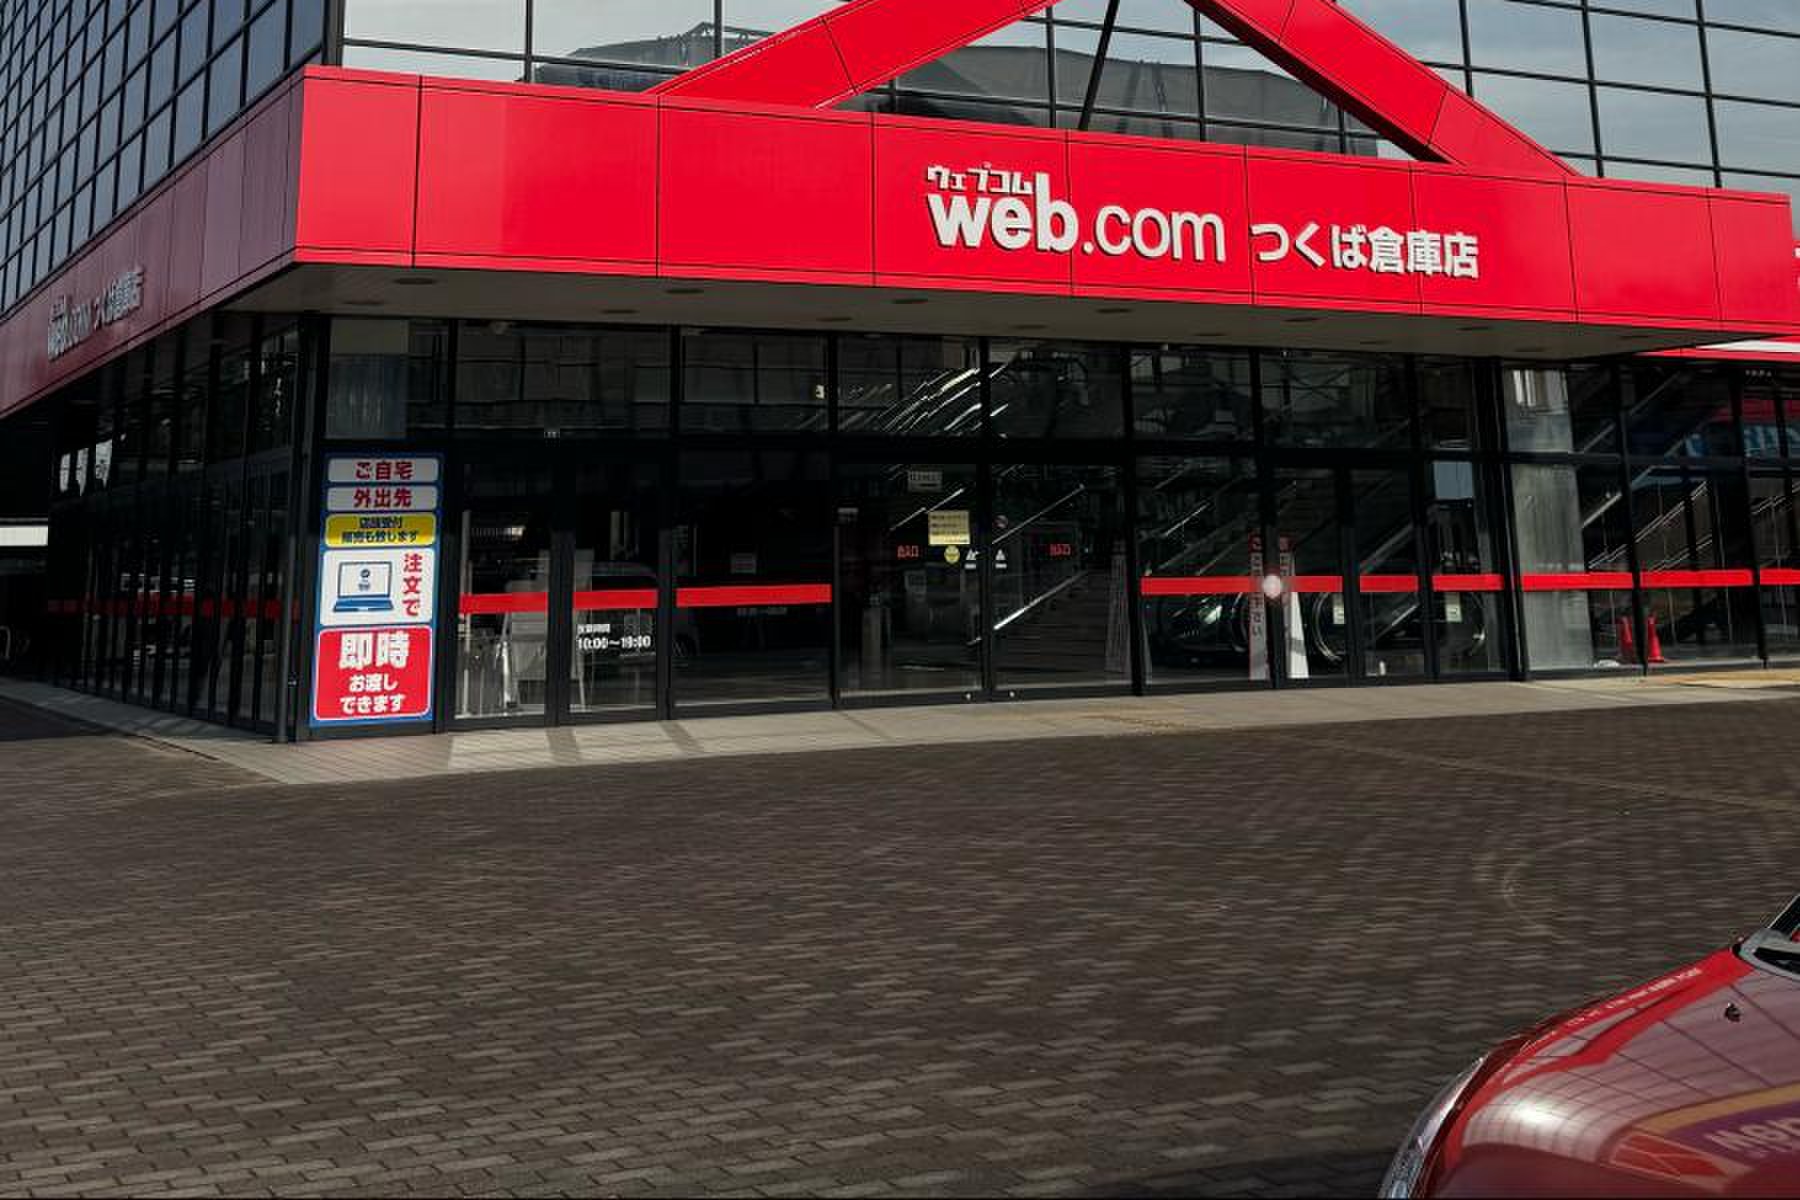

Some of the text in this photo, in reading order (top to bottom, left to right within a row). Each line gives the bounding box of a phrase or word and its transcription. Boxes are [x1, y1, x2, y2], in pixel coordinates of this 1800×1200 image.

[926, 163, 1034, 196] ウェブコム
[926, 171, 1481, 279] web.com つくば倉庫店
[355, 461, 413, 481] ご自宅
[353, 487, 413, 508] 外出先
[402, 552, 424, 617] 注文で
[338, 630, 411, 670] 即時
[348, 672, 398, 693] お渡し
[339, 693, 406, 714] できます
